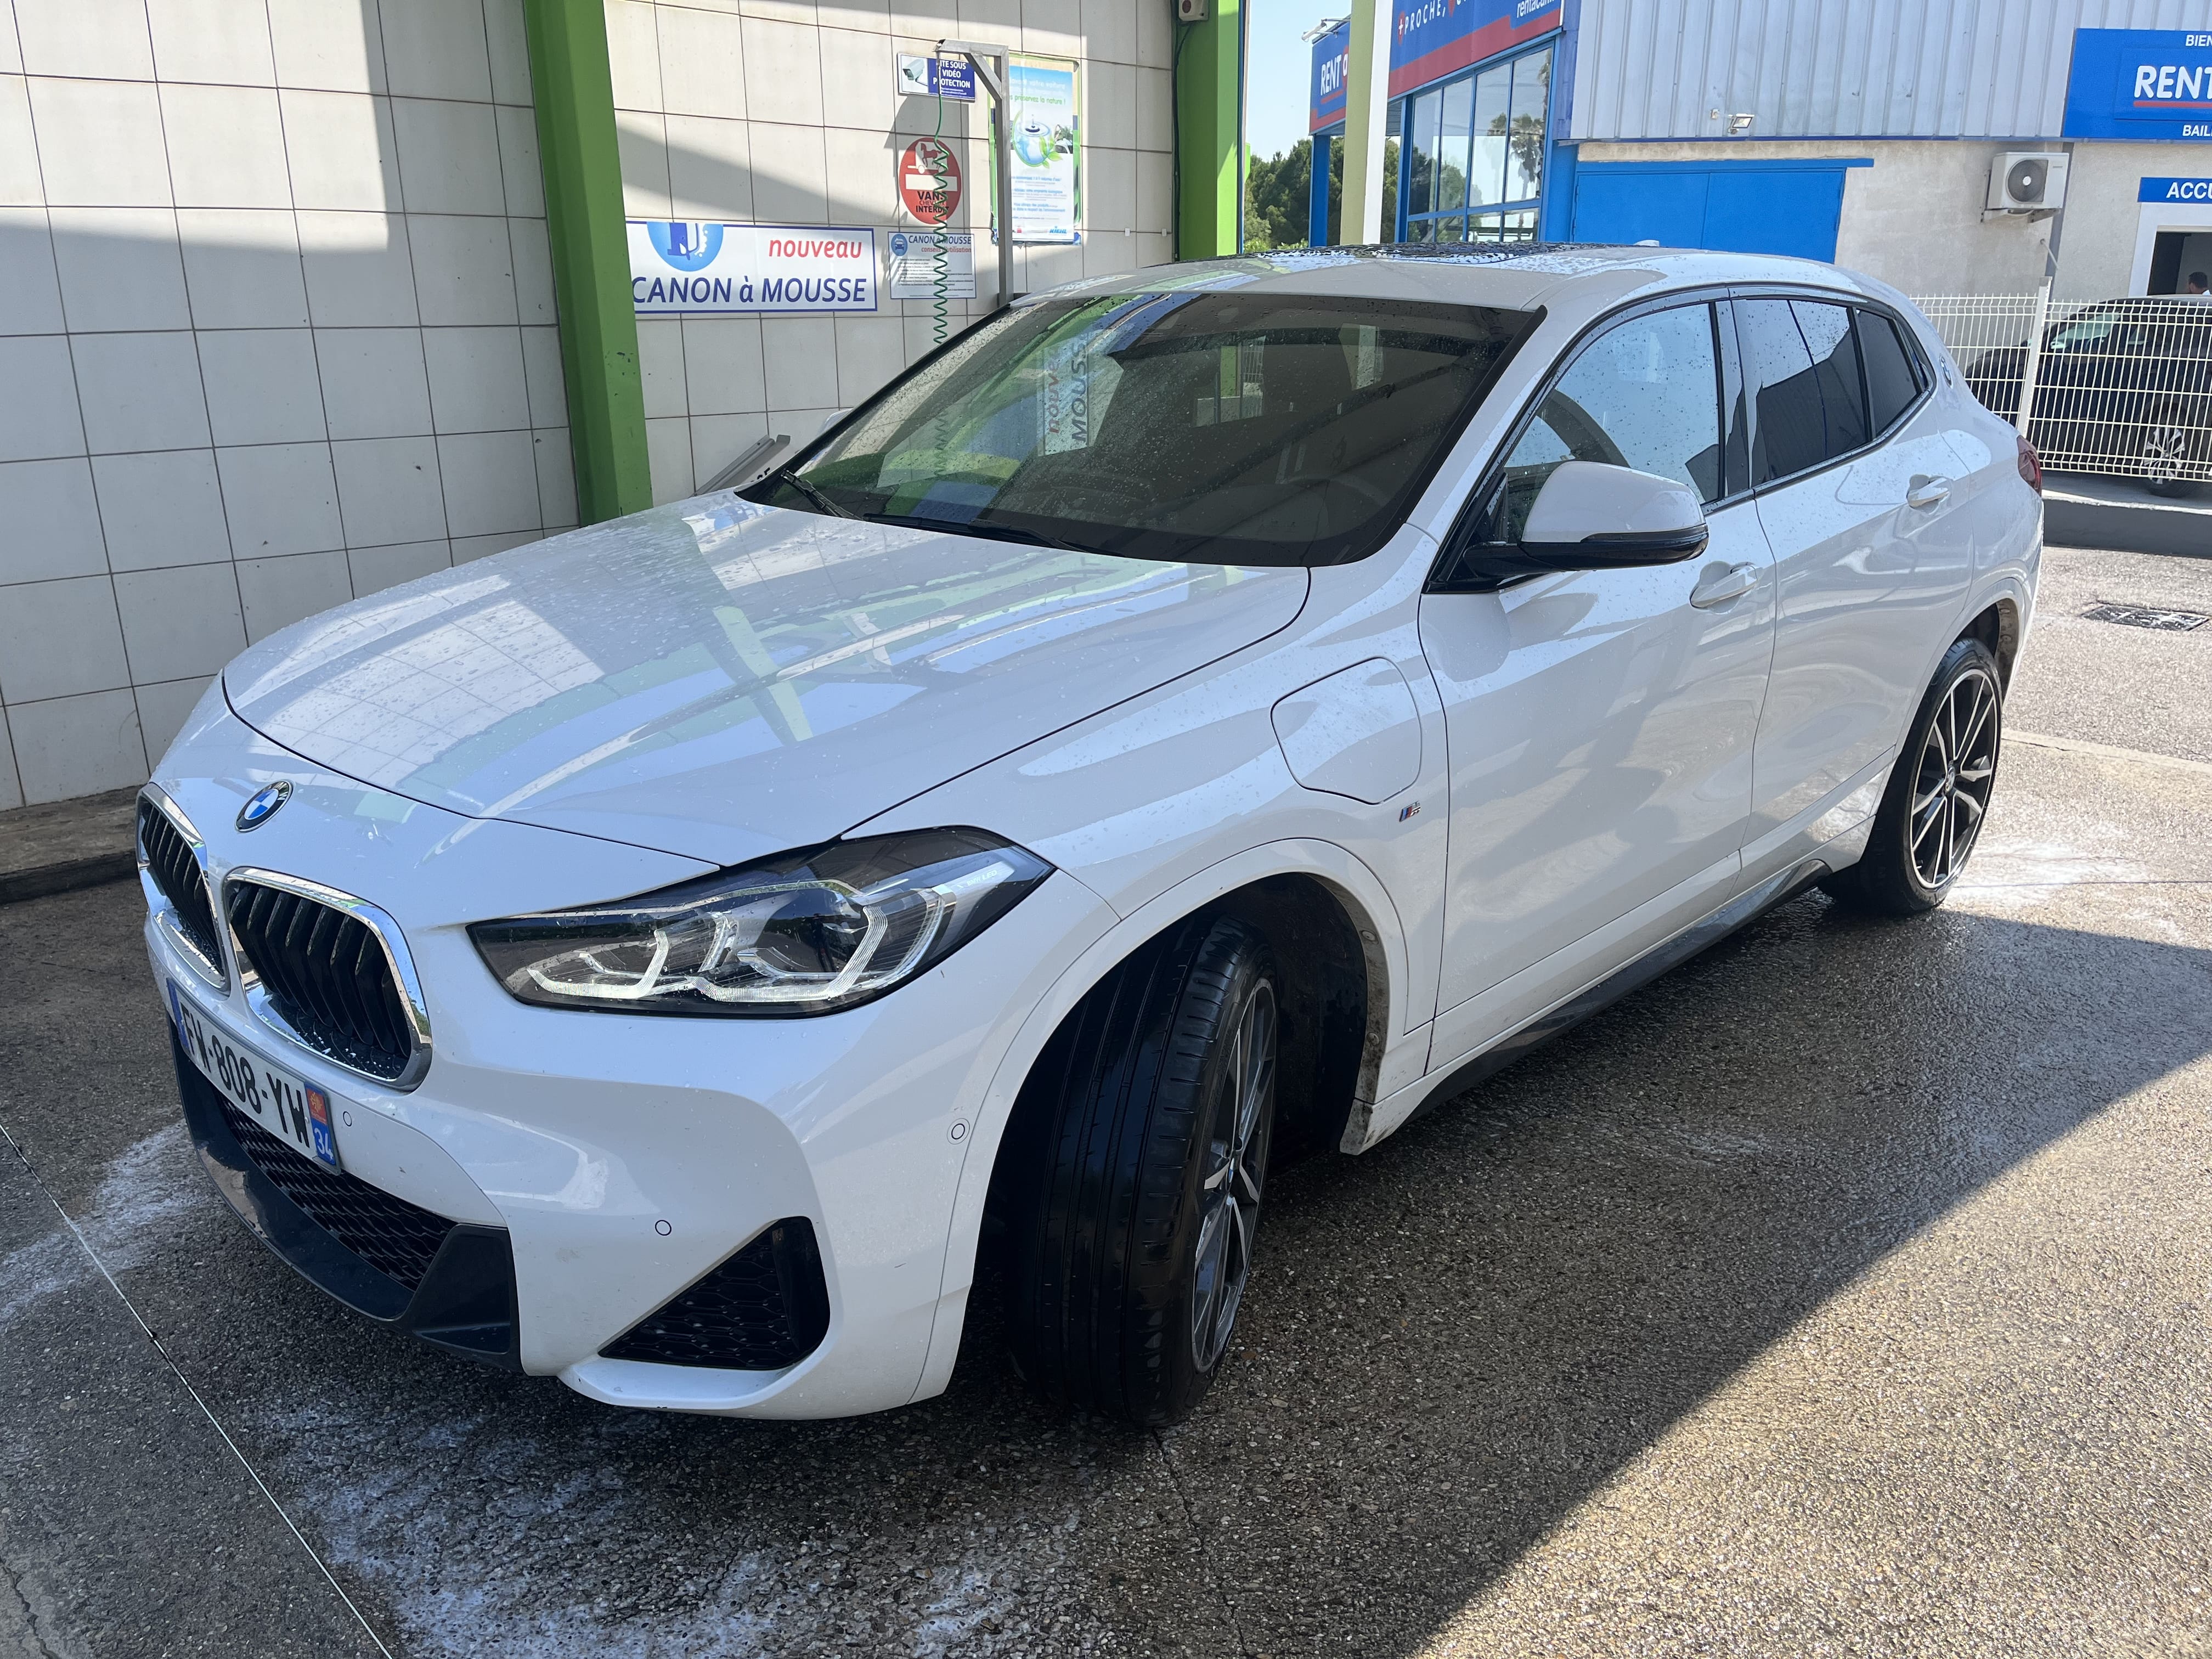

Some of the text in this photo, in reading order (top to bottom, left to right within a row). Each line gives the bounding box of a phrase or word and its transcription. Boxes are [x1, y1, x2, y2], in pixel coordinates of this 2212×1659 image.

[936, 60, 966, 70] ITE SOUS
[942, 69, 961, 78] VIDÉO
[1320, 54, 1342, 96] RENT
[933, 77, 970, 88] POTECTION
[2182, 125, 2212, 137] BAIL
[909, 235, 935, 244] CANON
[769, 239, 862, 258] nouveau
[632, 275, 867, 303] CANON à MOUSSE
[982, 870, 997, 880] LED
[314, 1127, 334, 1161] 34
